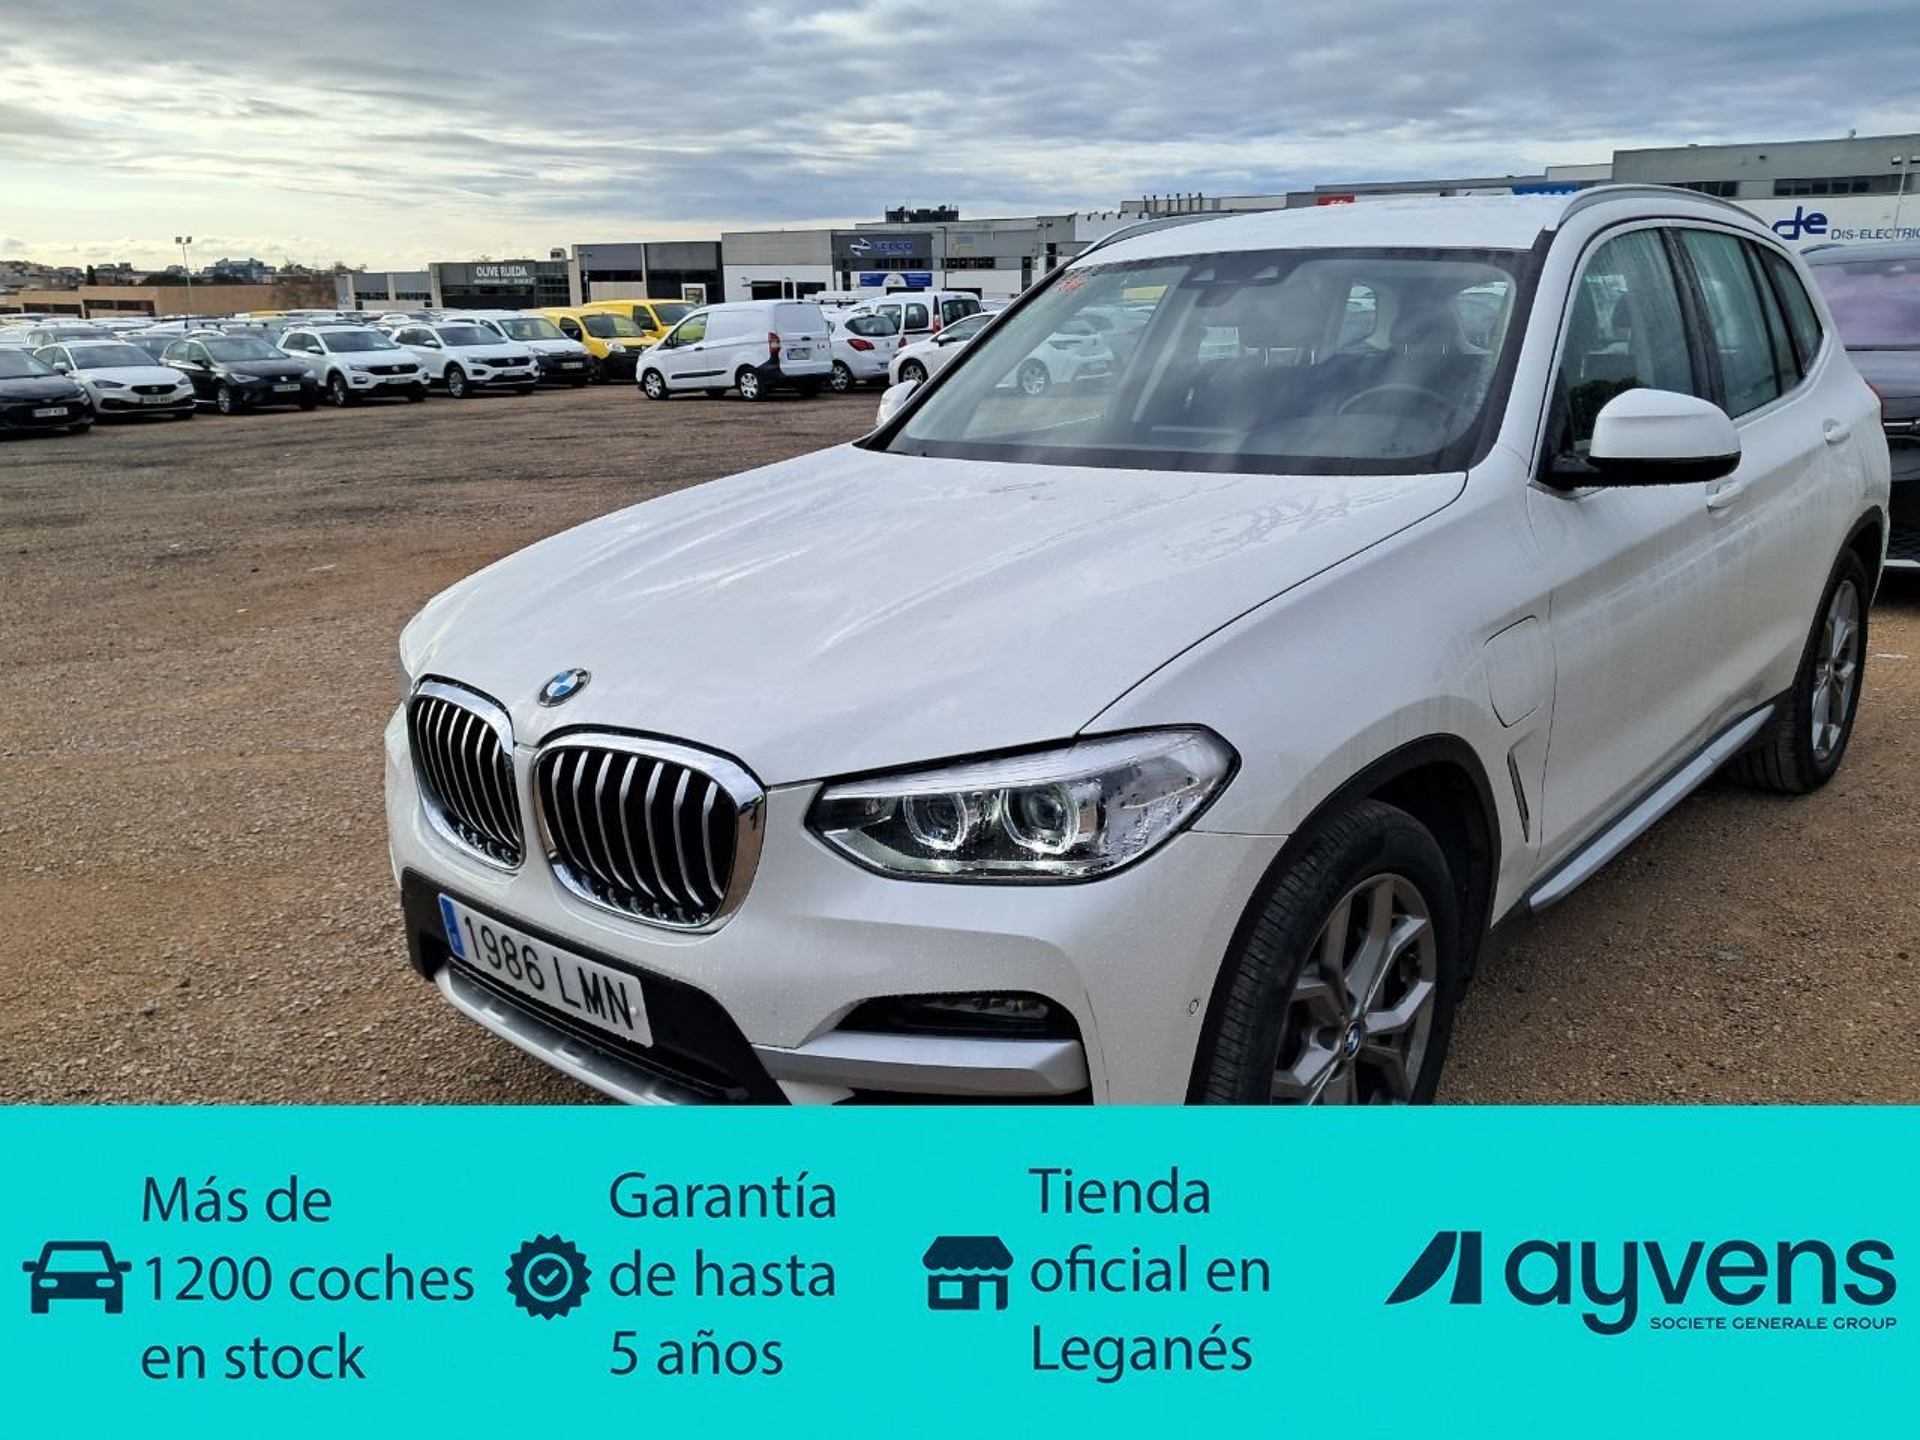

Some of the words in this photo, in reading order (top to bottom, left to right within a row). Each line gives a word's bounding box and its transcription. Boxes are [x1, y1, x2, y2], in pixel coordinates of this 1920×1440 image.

[476, 266, 499, 277] OLIVE
[500, 265, 528, 277] RUEDA
[464, 915, 545, 991] 1986
[553, 956, 635, 1031] LMN
